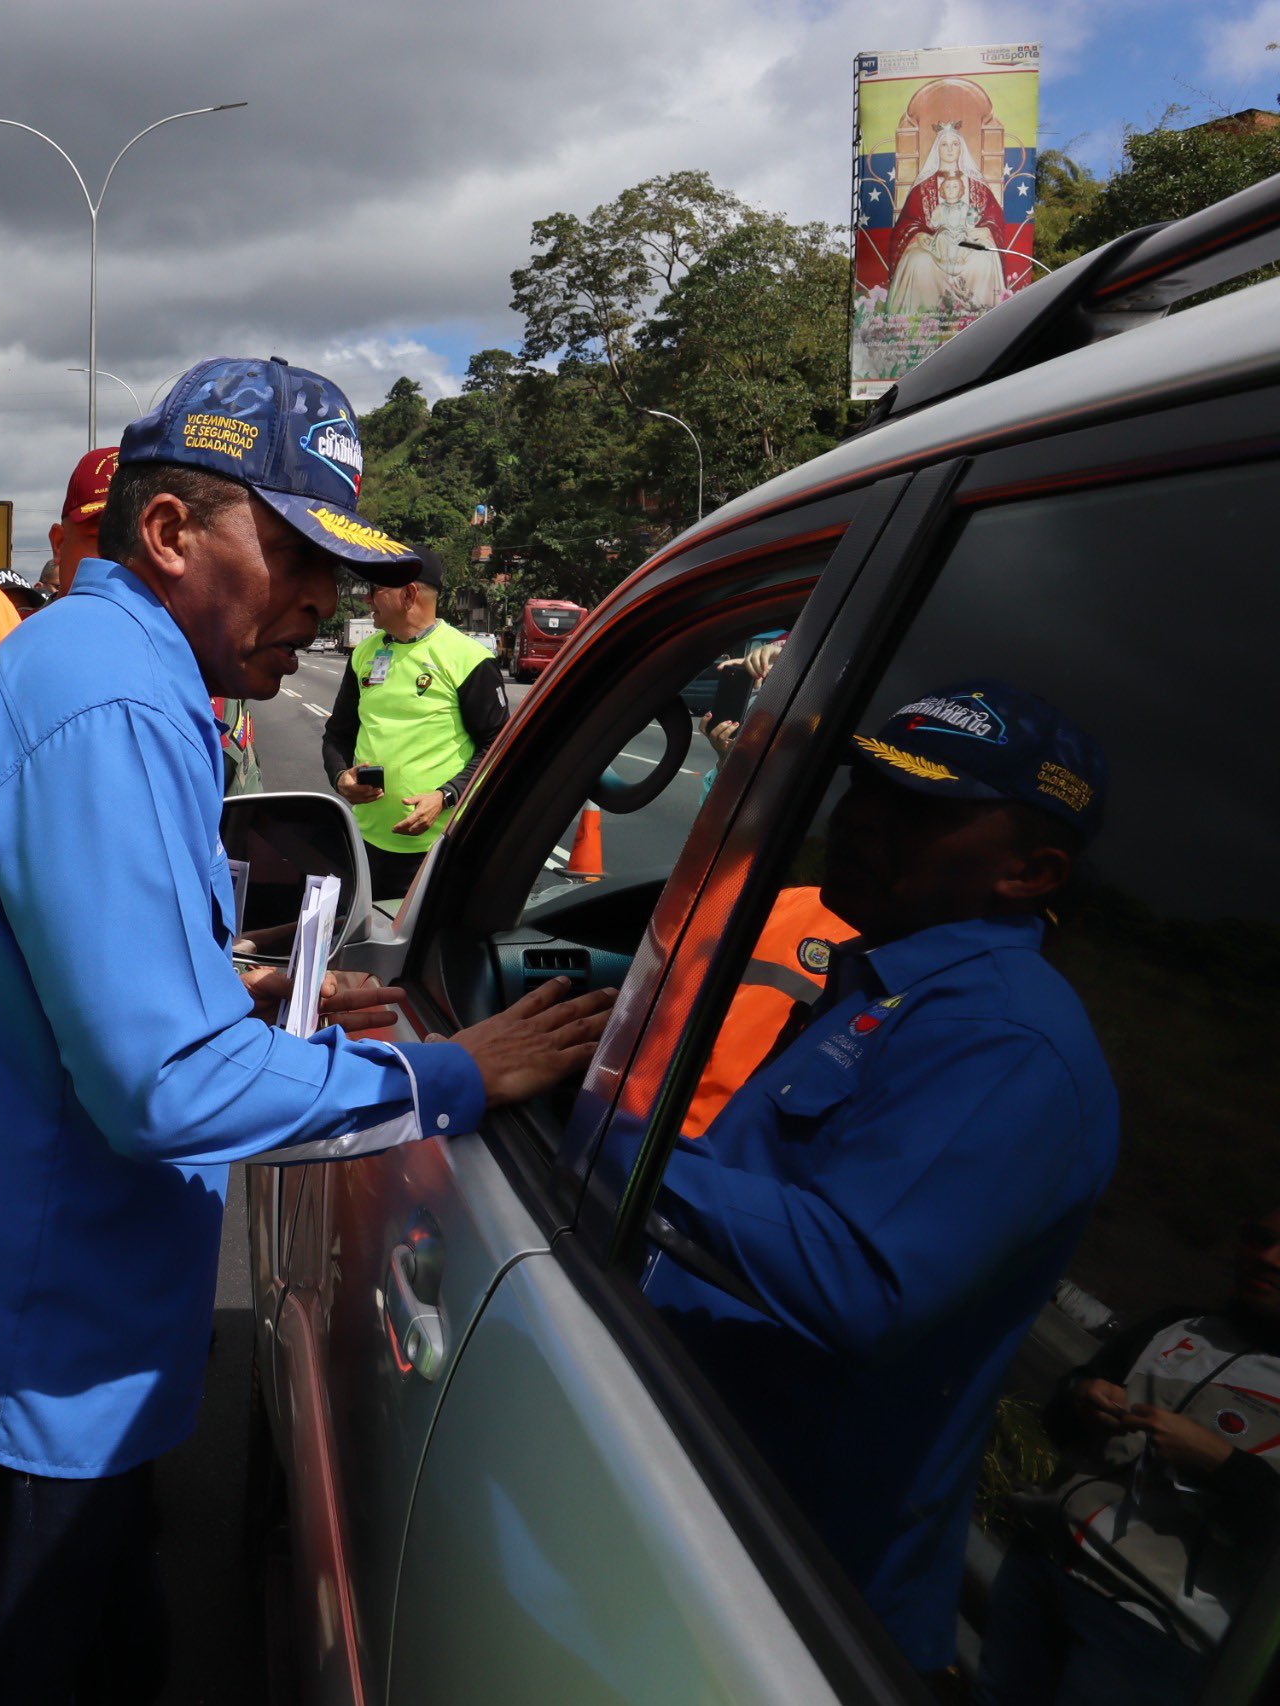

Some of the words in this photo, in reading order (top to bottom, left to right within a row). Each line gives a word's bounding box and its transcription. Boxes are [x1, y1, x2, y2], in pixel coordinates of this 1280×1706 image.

[980, 51, 1040, 61] Transporte
[183, 425, 198, 435] DE
[198, 426, 254, 449] SEGURIDAD
[187, 414, 259, 438] VICEMINISTRO
[326, 426, 351, 447] Gran
[185, 436, 243, 460] CIUDADANA
